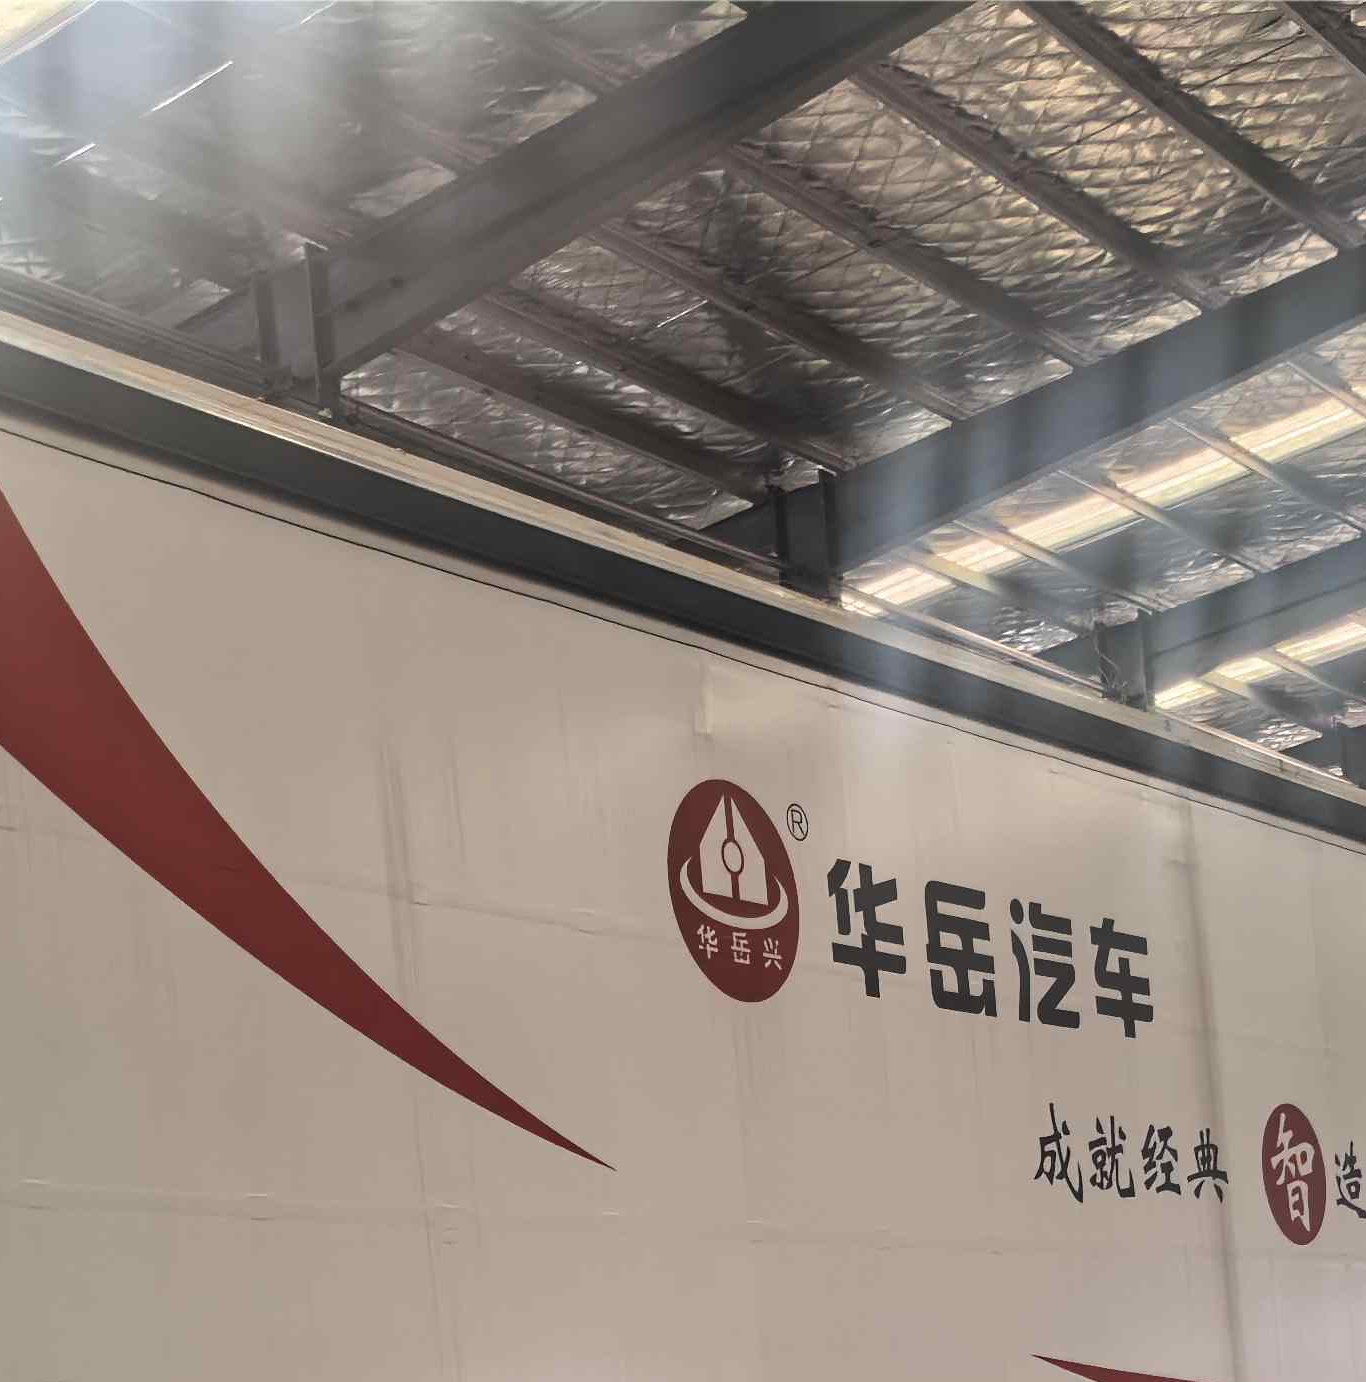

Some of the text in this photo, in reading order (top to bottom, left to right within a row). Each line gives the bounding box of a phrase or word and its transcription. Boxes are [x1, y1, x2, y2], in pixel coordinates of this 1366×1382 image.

[696, 924, 783, 971] 华岳兴
[826, 858, 1154, 1039] 华岳汽车
[1033, 1102, 1229, 1204] 成就经典
